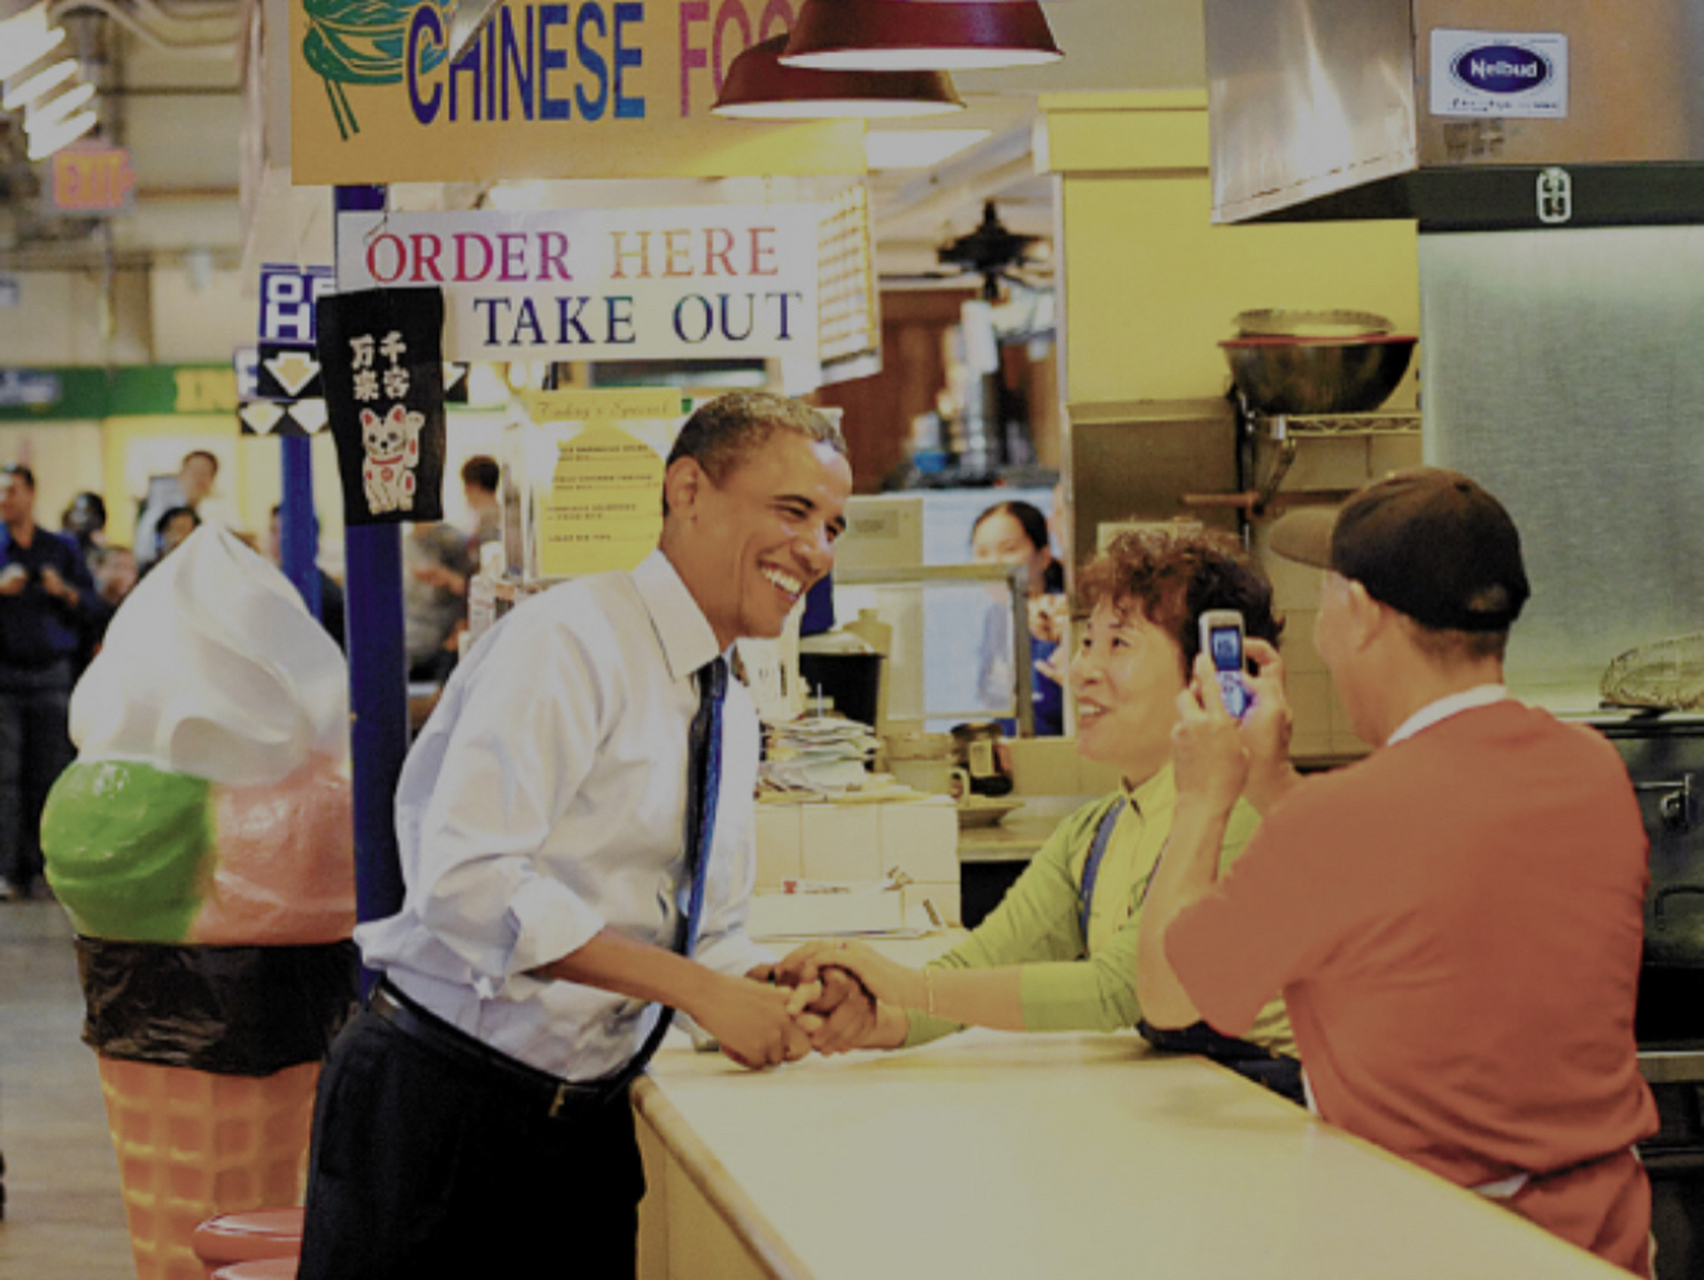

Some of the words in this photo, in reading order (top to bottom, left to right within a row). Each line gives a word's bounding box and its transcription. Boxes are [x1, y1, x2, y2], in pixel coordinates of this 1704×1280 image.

[407, 1, 645, 124] CHINESE
[679, 0, 796, 118] FO
[1471, 59, 1537, 79] Nelbud
[58, 154, 121, 204] EXIT
[366, 232, 573, 282] ORDER
[610, 227, 779, 279] HERE
[474, 295, 636, 346] TAKE
[672, 292, 802, 344] OUT
